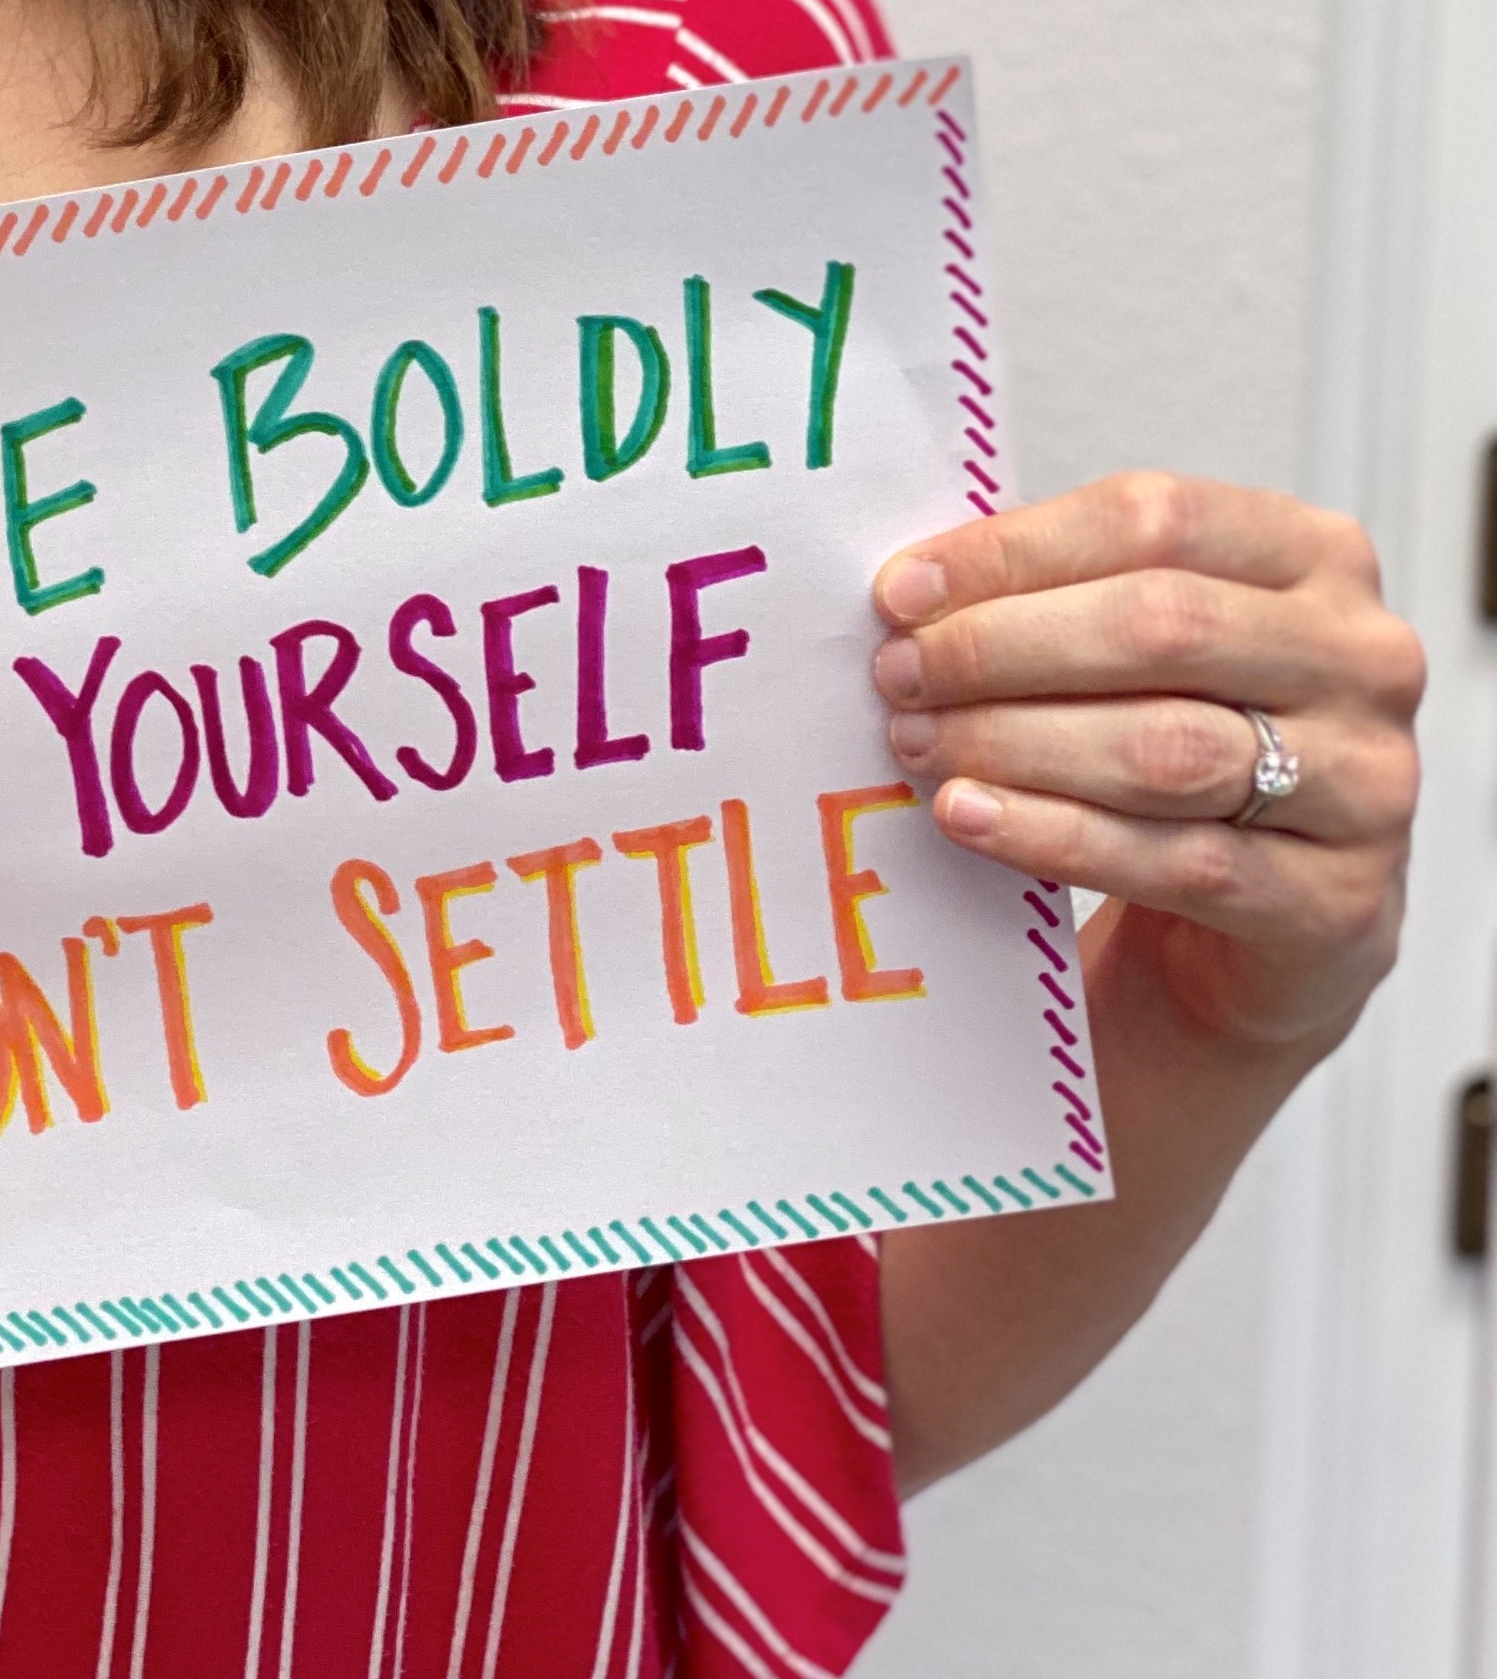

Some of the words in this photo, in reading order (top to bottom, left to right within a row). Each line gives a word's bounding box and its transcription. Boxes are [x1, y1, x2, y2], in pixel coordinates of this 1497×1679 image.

[210, 260, 855, 577] BOLDLY
[13, 544, 767, 858] YOURSELF
[326, 782, 927, 1098] SETTLE
